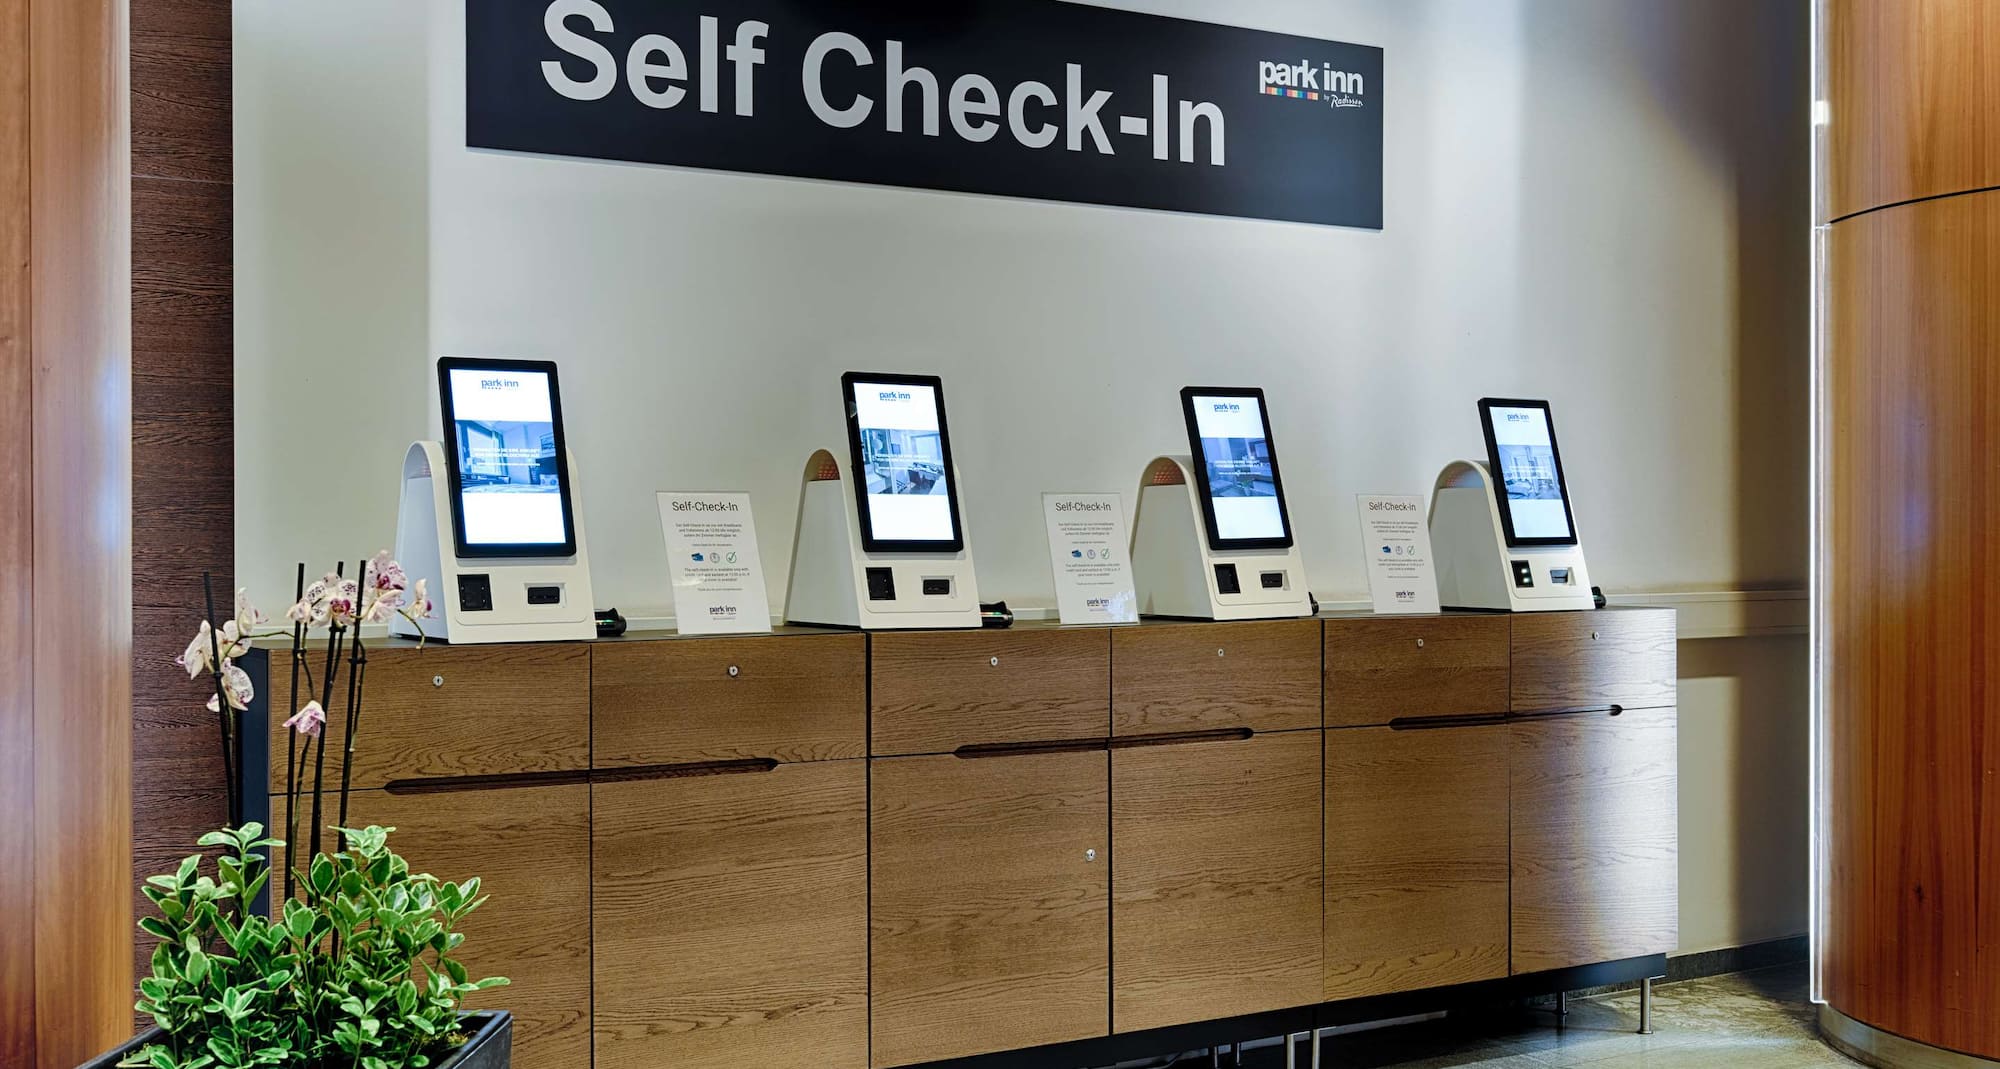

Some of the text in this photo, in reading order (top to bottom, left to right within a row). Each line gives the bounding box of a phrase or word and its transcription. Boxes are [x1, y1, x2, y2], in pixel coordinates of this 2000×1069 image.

[1259, 59, 1363, 95] park inn
[541, 0, 1225, 166] Self Check-In
[481, 379, 519, 389] park inn
[879, 391, 910, 401] park inn
[1214, 403, 1228, 412] park
[671, 501, 738, 512] Self-Check-In
[1055, 502, 1111, 512] Self-Check-In
[1368, 502, 1416, 511] Self-Check-In
[709, 606, 725, 615] park
